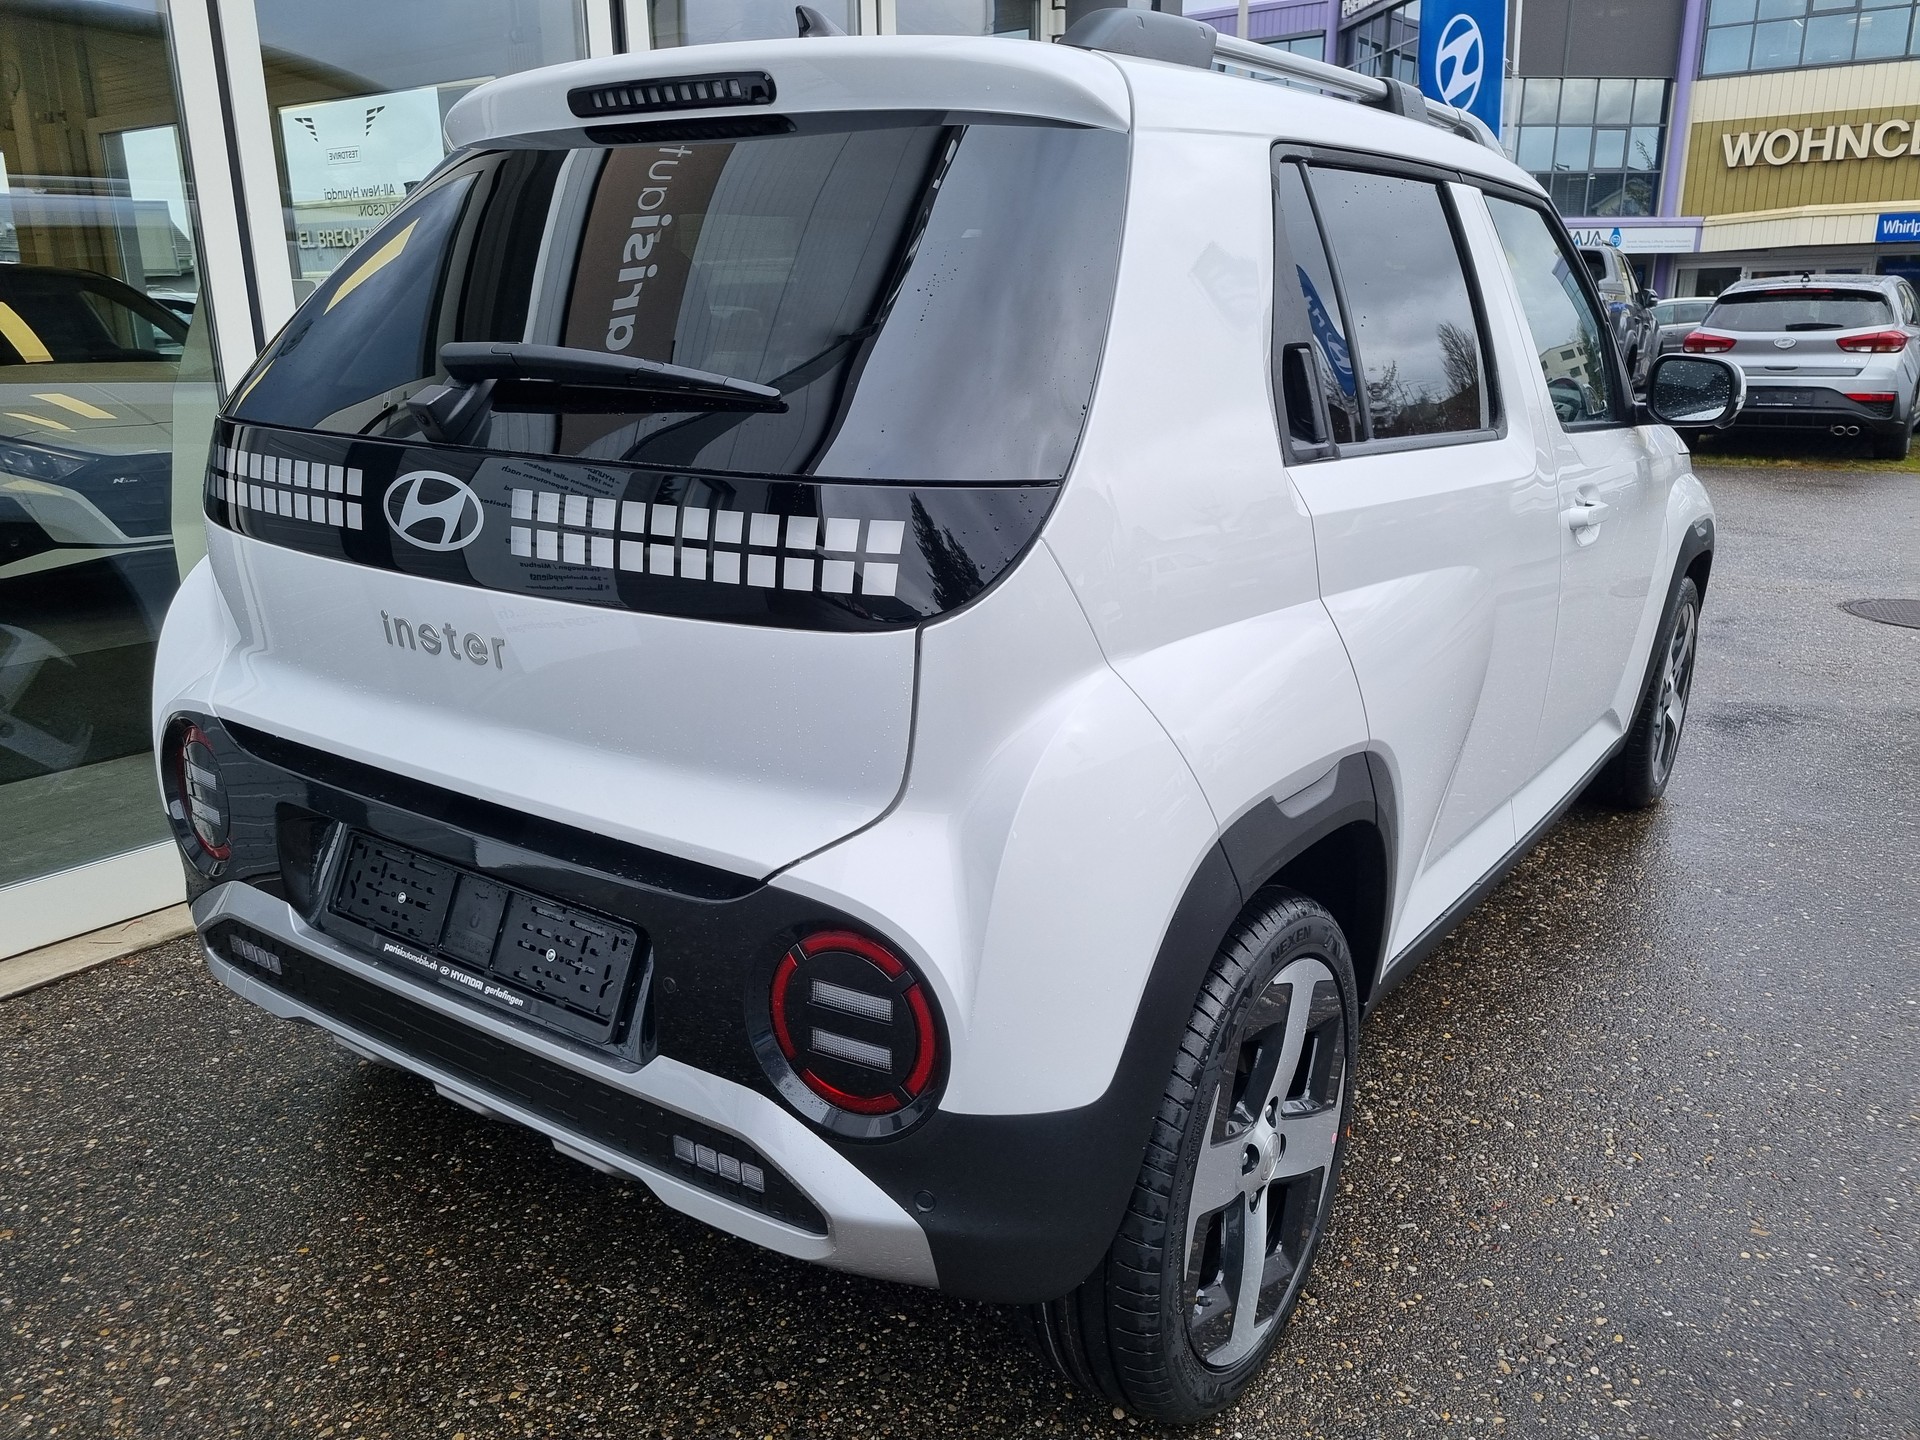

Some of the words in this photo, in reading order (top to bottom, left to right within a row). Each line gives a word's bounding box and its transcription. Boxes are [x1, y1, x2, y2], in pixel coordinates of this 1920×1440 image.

[380, 608, 506, 671] inster
[1270, 924, 1312, 965] NEXEN
[450, 969, 484, 991] HYUNDAI
[484, 985, 524, 1007] gerlafingen
